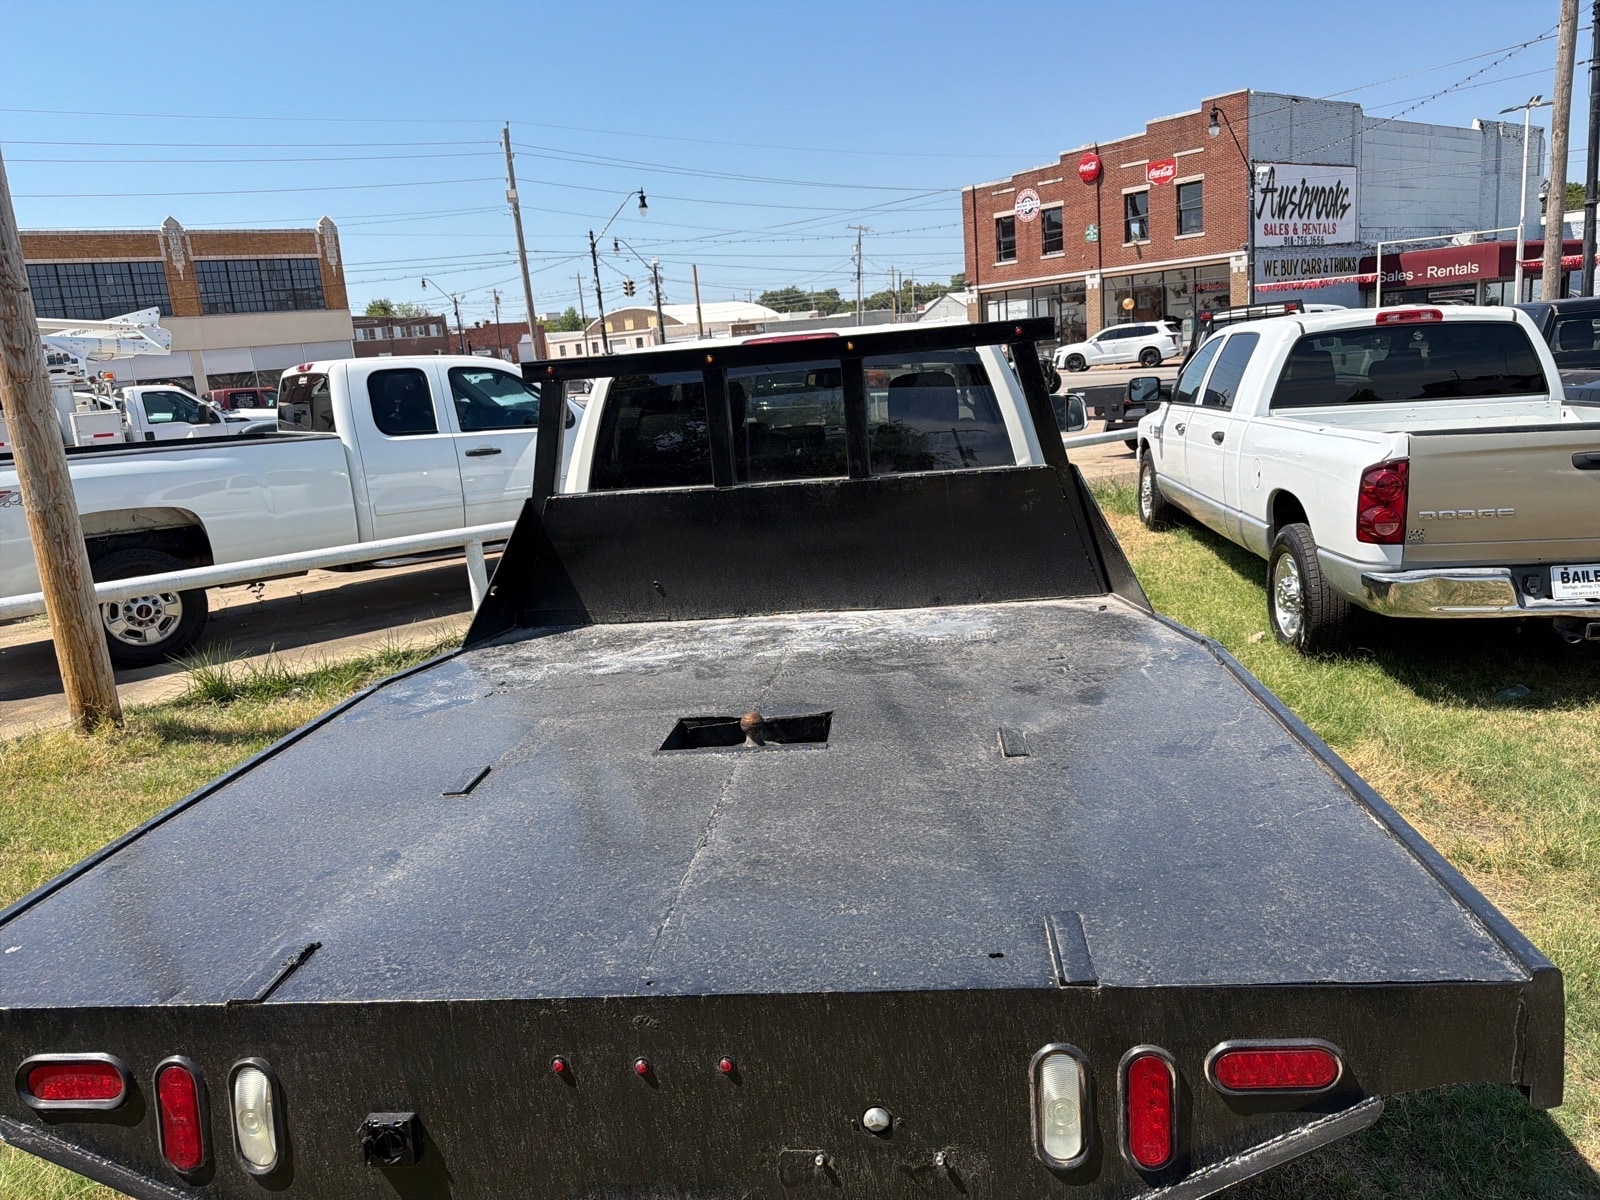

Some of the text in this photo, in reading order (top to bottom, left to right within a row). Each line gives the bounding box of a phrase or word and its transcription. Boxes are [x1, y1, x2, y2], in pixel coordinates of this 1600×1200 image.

[1149, 166, 1174, 179] Coca-Cola
[1256, 165, 1351, 220] Ausbrooks
[1264, 223, 1336, 236] SALES & RENTALS
[1264, 261, 1278, 277] WE
[1280, 259, 1299, 276] BUY
[1300, 258, 1322, 275] CARS
[1329, 256, 1357, 273] TRUCKS
[1379, 270, 1414, 283] Sales
[1427, 261, 1480, 279] Rentals
[1418, 508, 1515, 520] DODGE
